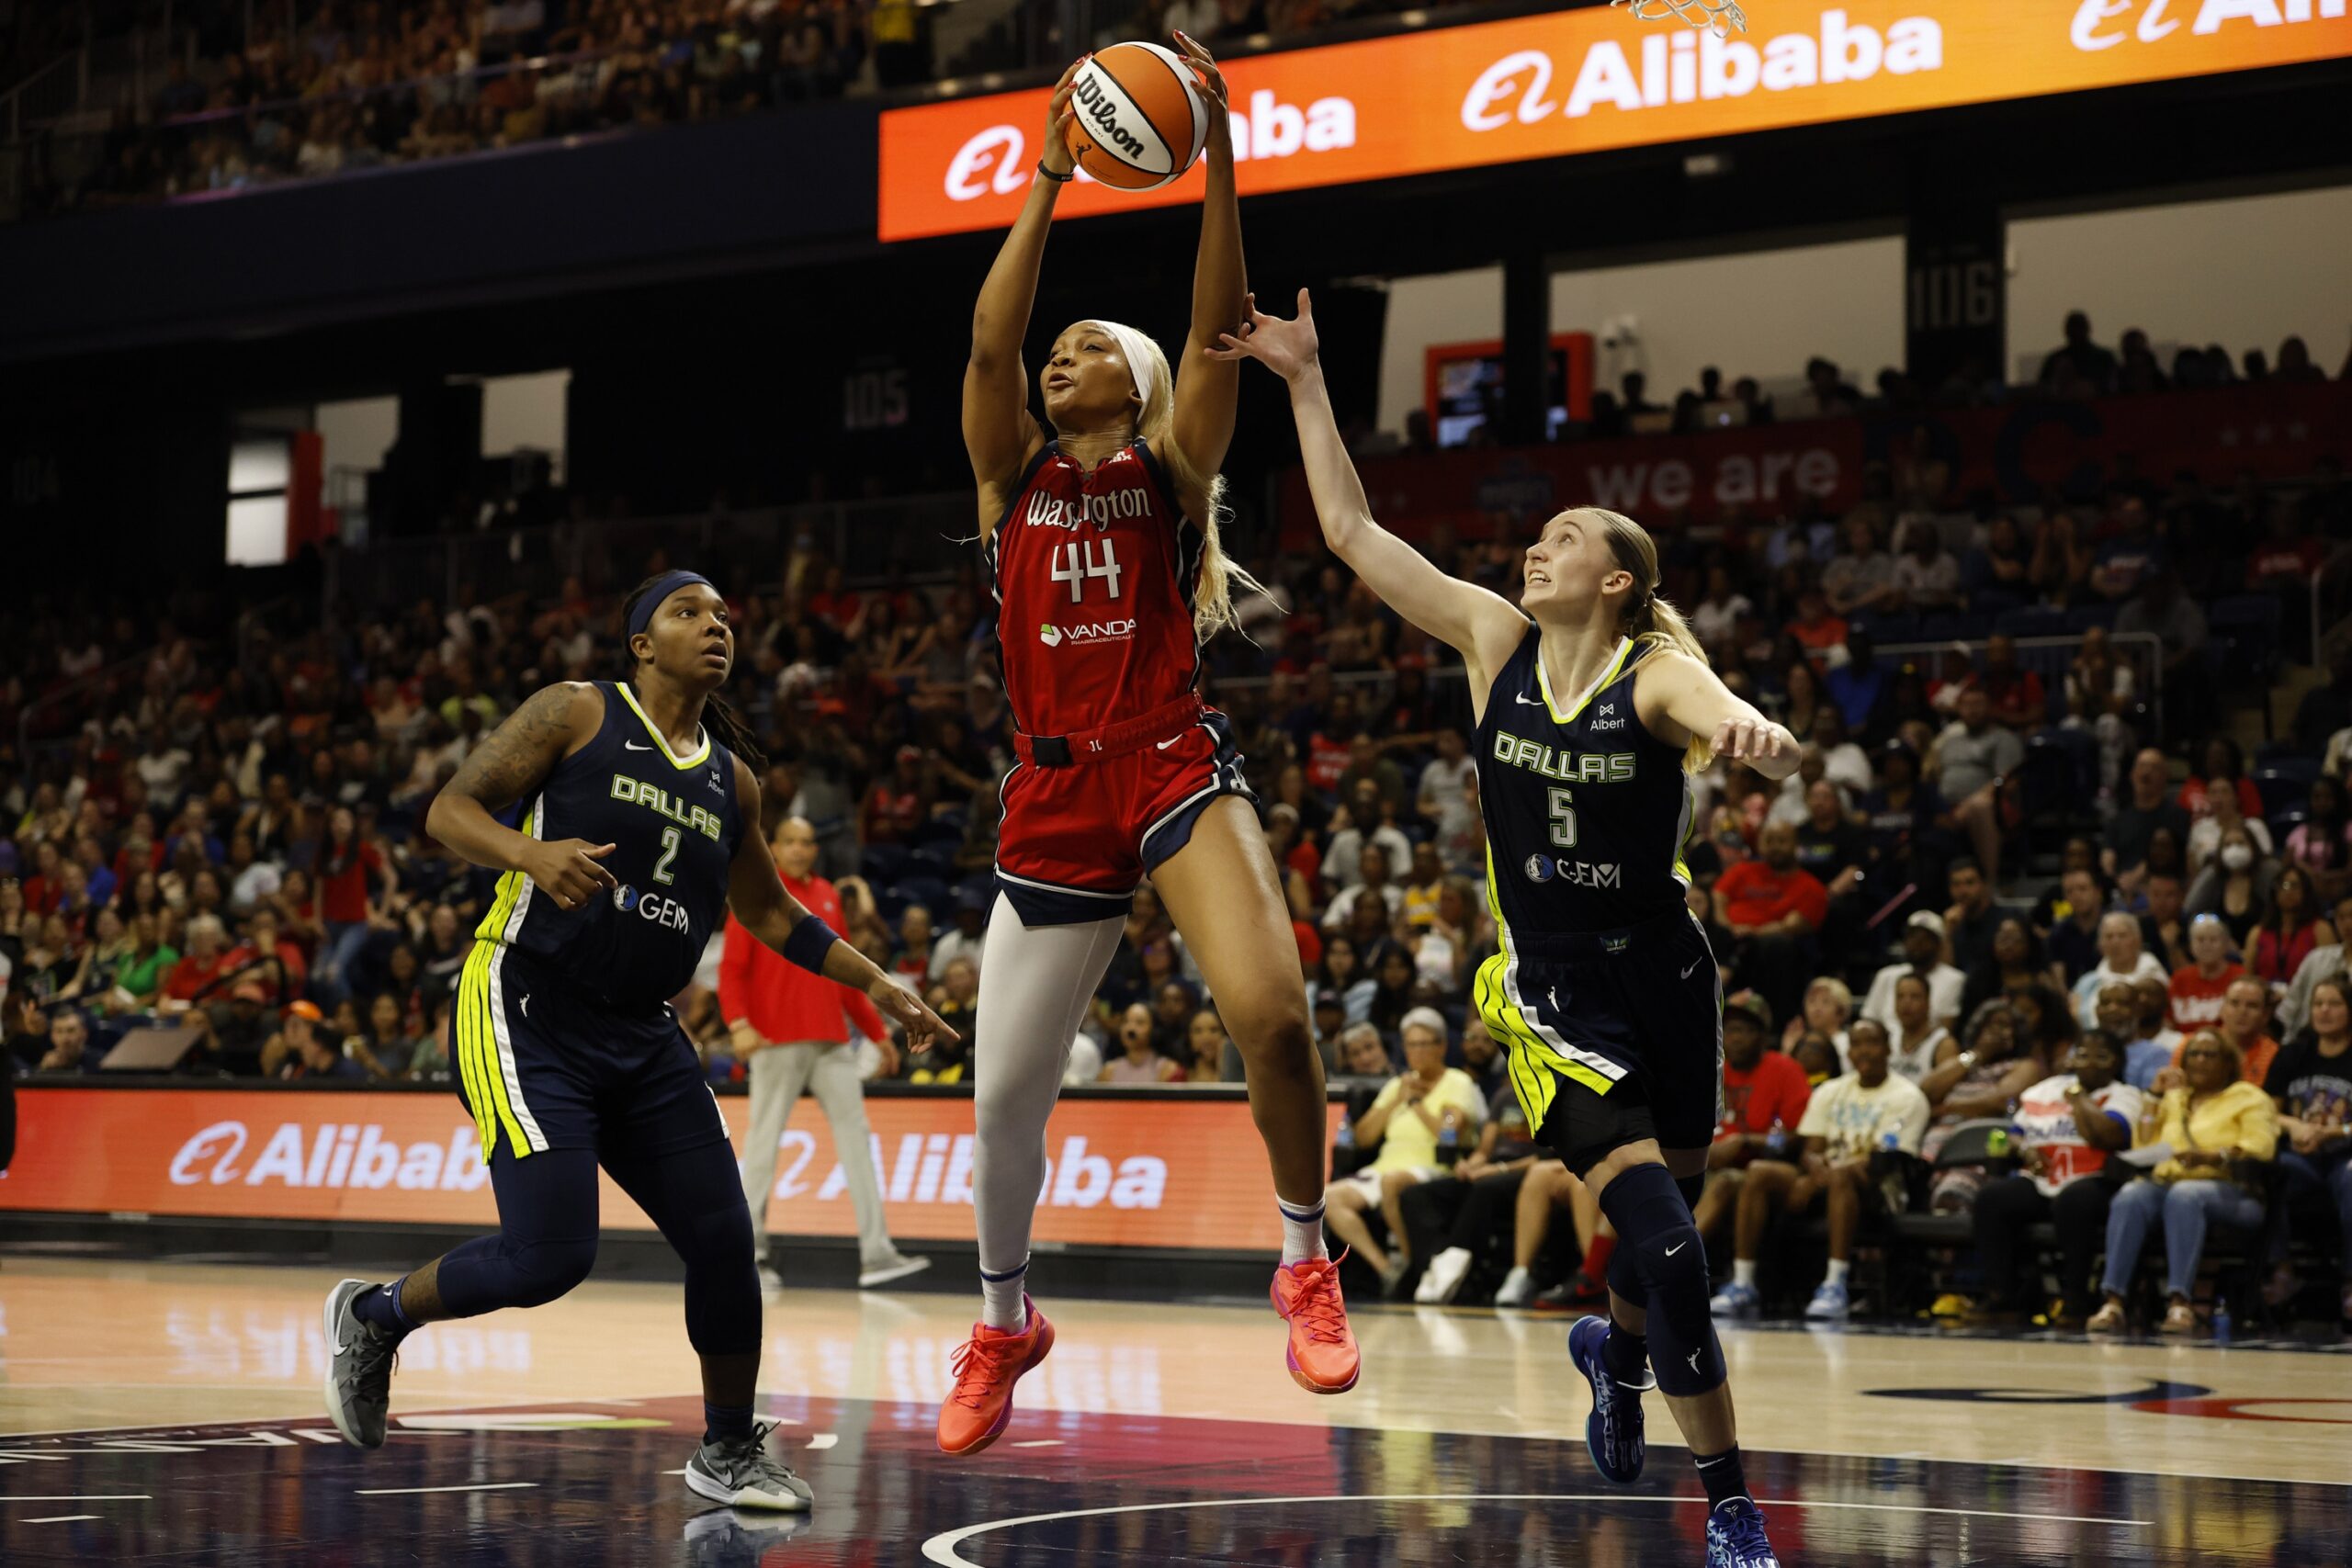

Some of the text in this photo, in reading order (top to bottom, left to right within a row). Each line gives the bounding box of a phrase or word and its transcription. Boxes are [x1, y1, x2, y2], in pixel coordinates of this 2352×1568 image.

[1564, 9, 1942, 118] Alibaba
[1076, 72, 1145, 160] Wilson
[1910, 260, 1996, 327] 106
[843, 369, 910, 428] 105
[1587, 458, 1694, 511] we
[1713, 447, 1839, 503] are
[1051, 537, 1121, 603] 44
[1063, 618, 1136, 639] VANDA
[1589, 716, 1625, 731] Albert
[1493, 730, 1637, 784] DALLAS
[610, 773, 723, 842] DALLAS
[1547, 786, 1577, 849] 5
[651, 826, 683, 886] 2
[1556, 858, 1621, 889] GEM
[639, 893, 690, 935] GEM
[244, 1122, 491, 1191] Alibab
